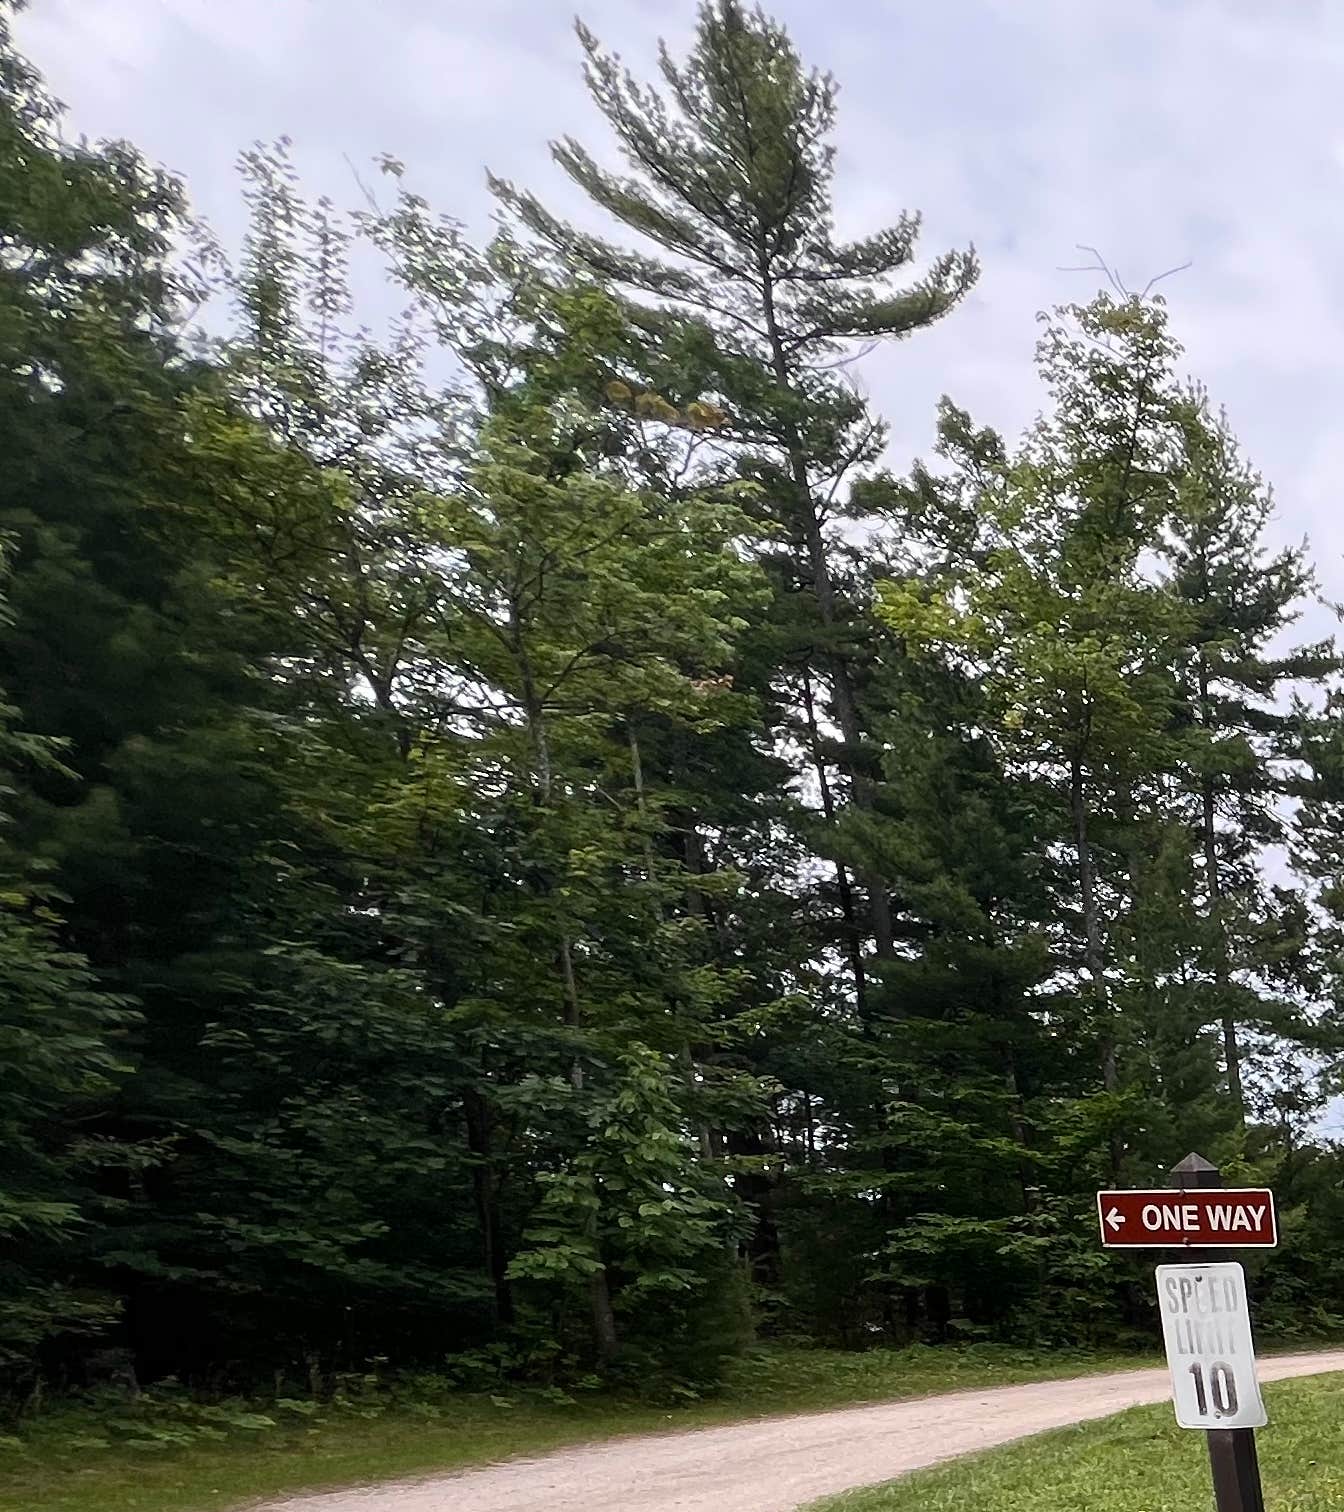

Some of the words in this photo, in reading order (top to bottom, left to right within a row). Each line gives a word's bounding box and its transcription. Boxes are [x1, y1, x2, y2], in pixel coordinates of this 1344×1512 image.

[1142, 1204, 1200, 1231] ONE
[1205, 1204, 1266, 1231] WAY
[1189, 1361, 1239, 1418] 10
